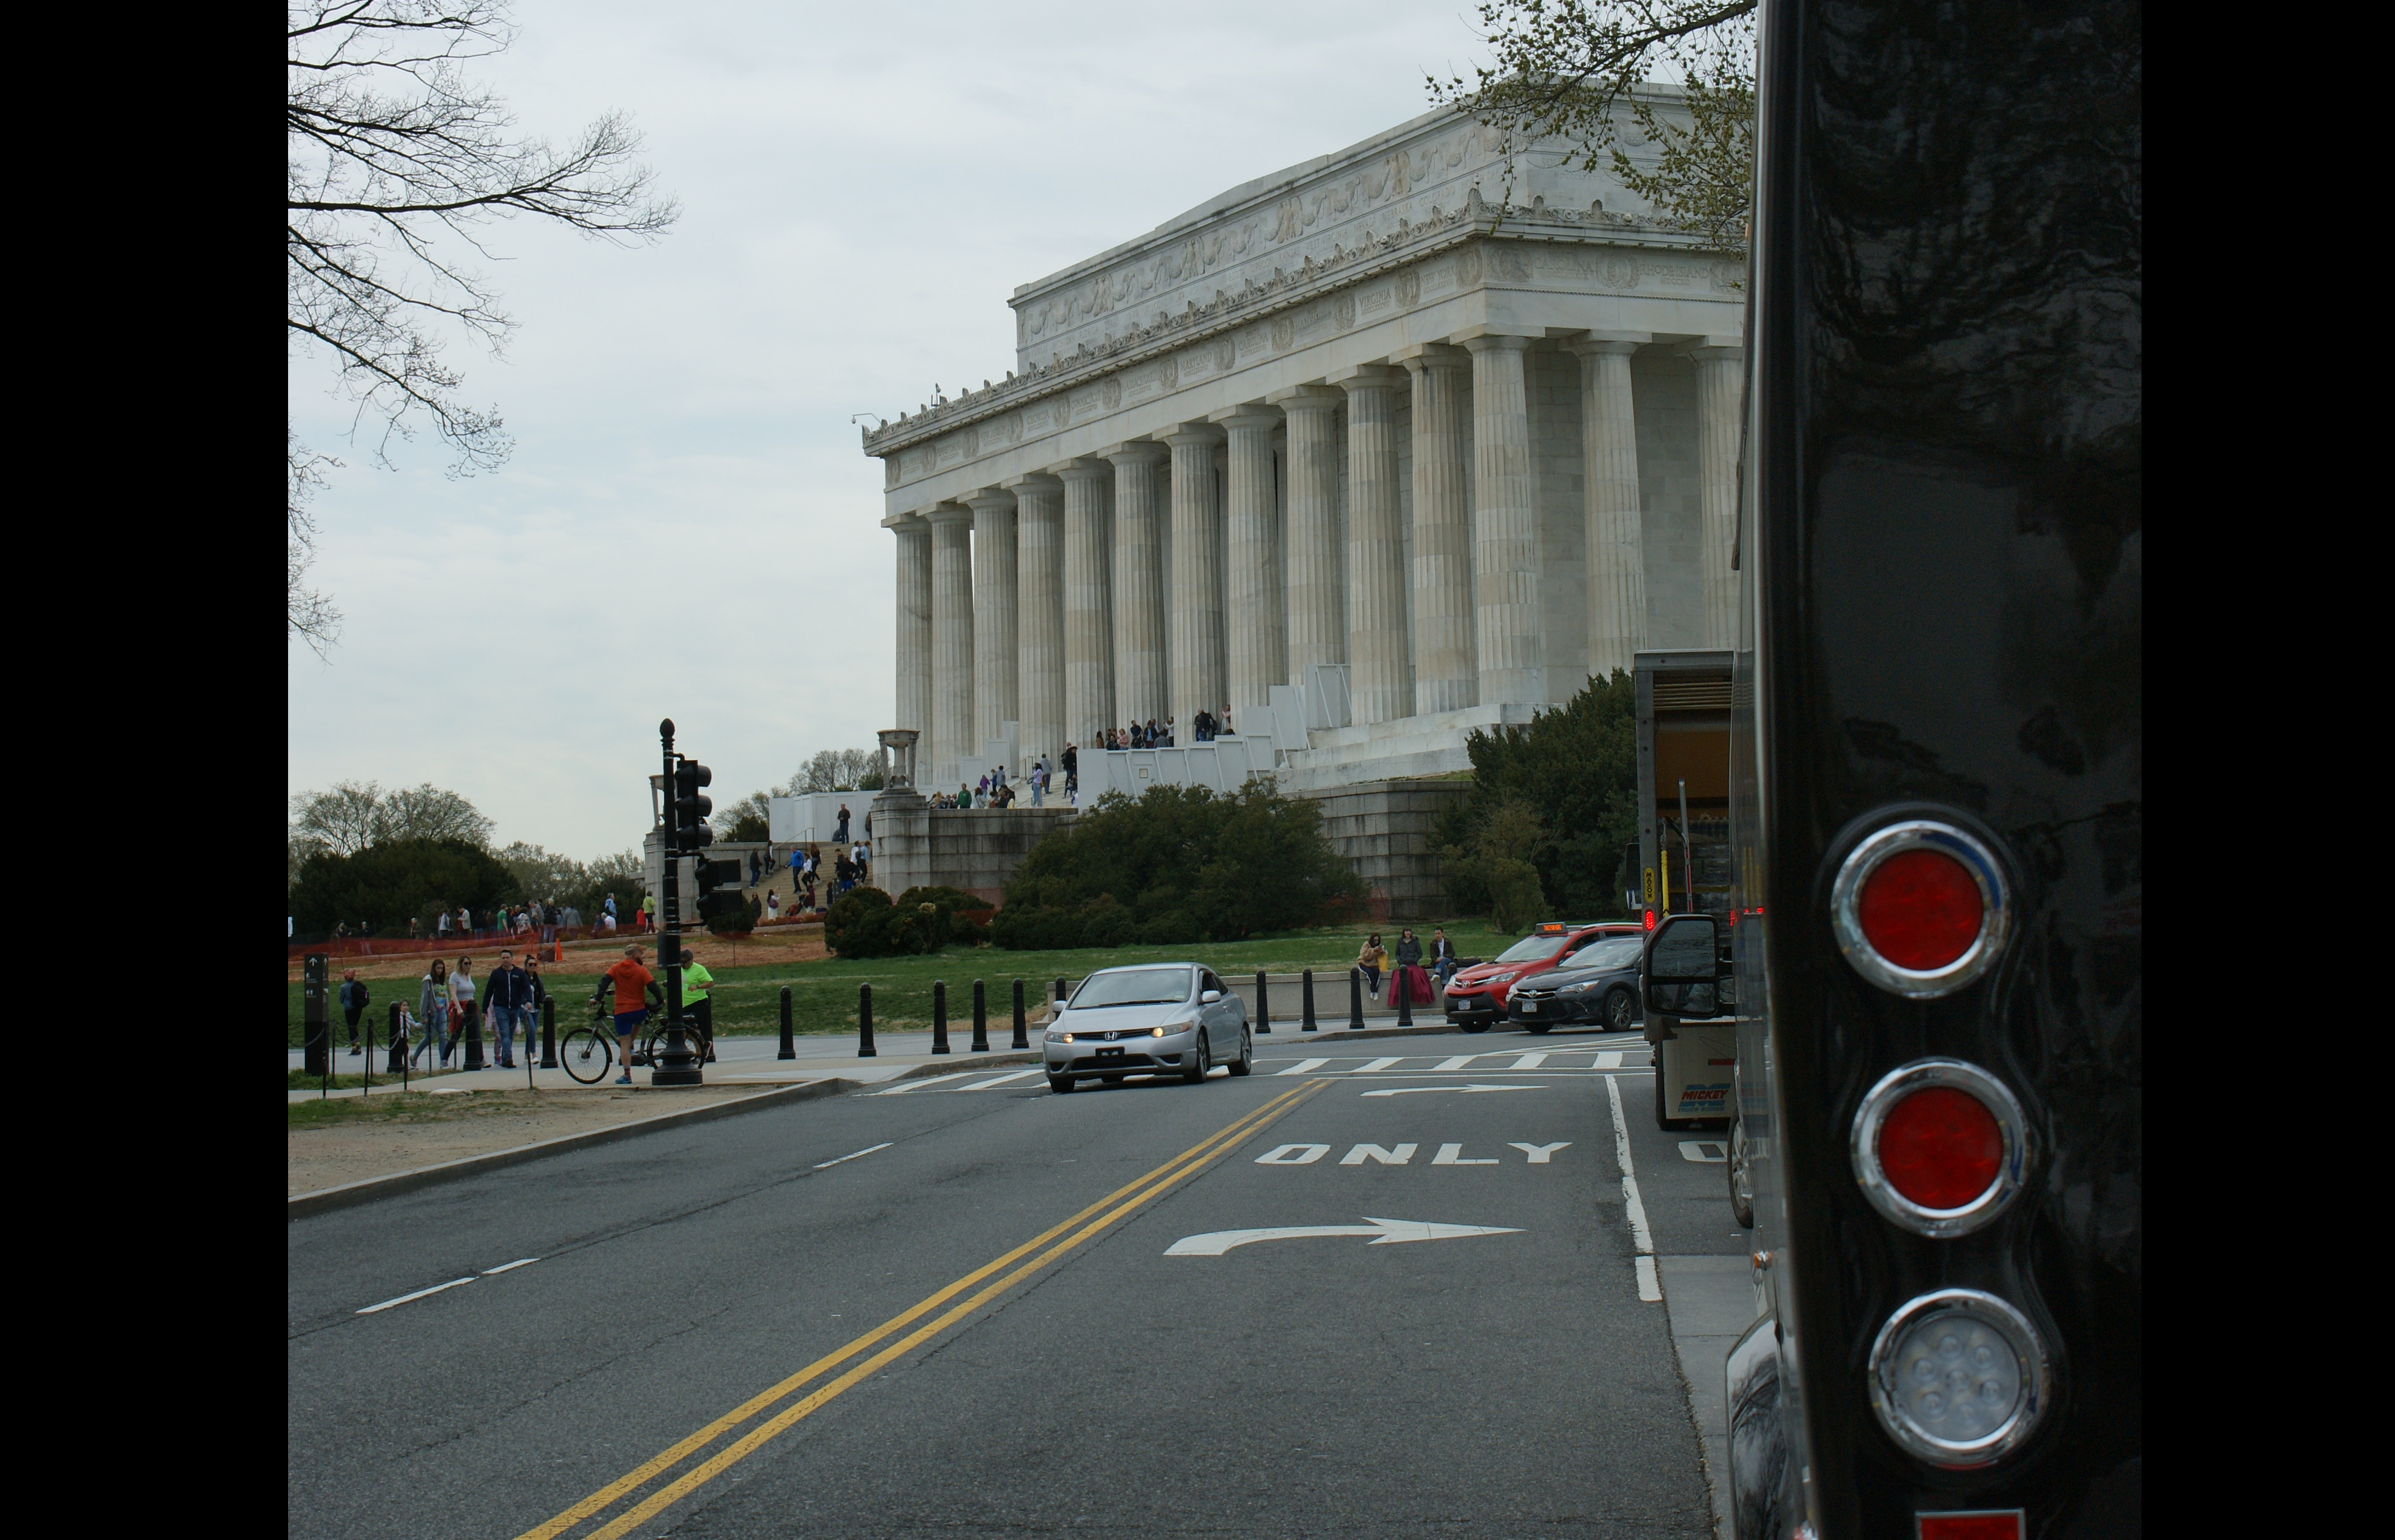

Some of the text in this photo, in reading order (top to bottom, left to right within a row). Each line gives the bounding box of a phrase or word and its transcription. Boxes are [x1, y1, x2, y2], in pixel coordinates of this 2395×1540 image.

[1420, 264, 1456, 286] NEW YORK
[1359, 287, 1391, 309] VIRGINIA
[1180, 351, 1212, 371] MARYLAND
[1027, 408, 1049, 425] GEORGIA
[1681, 1089, 1729, 1100] MICKEY
[1254, 1142, 1573, 1165] ONLY
